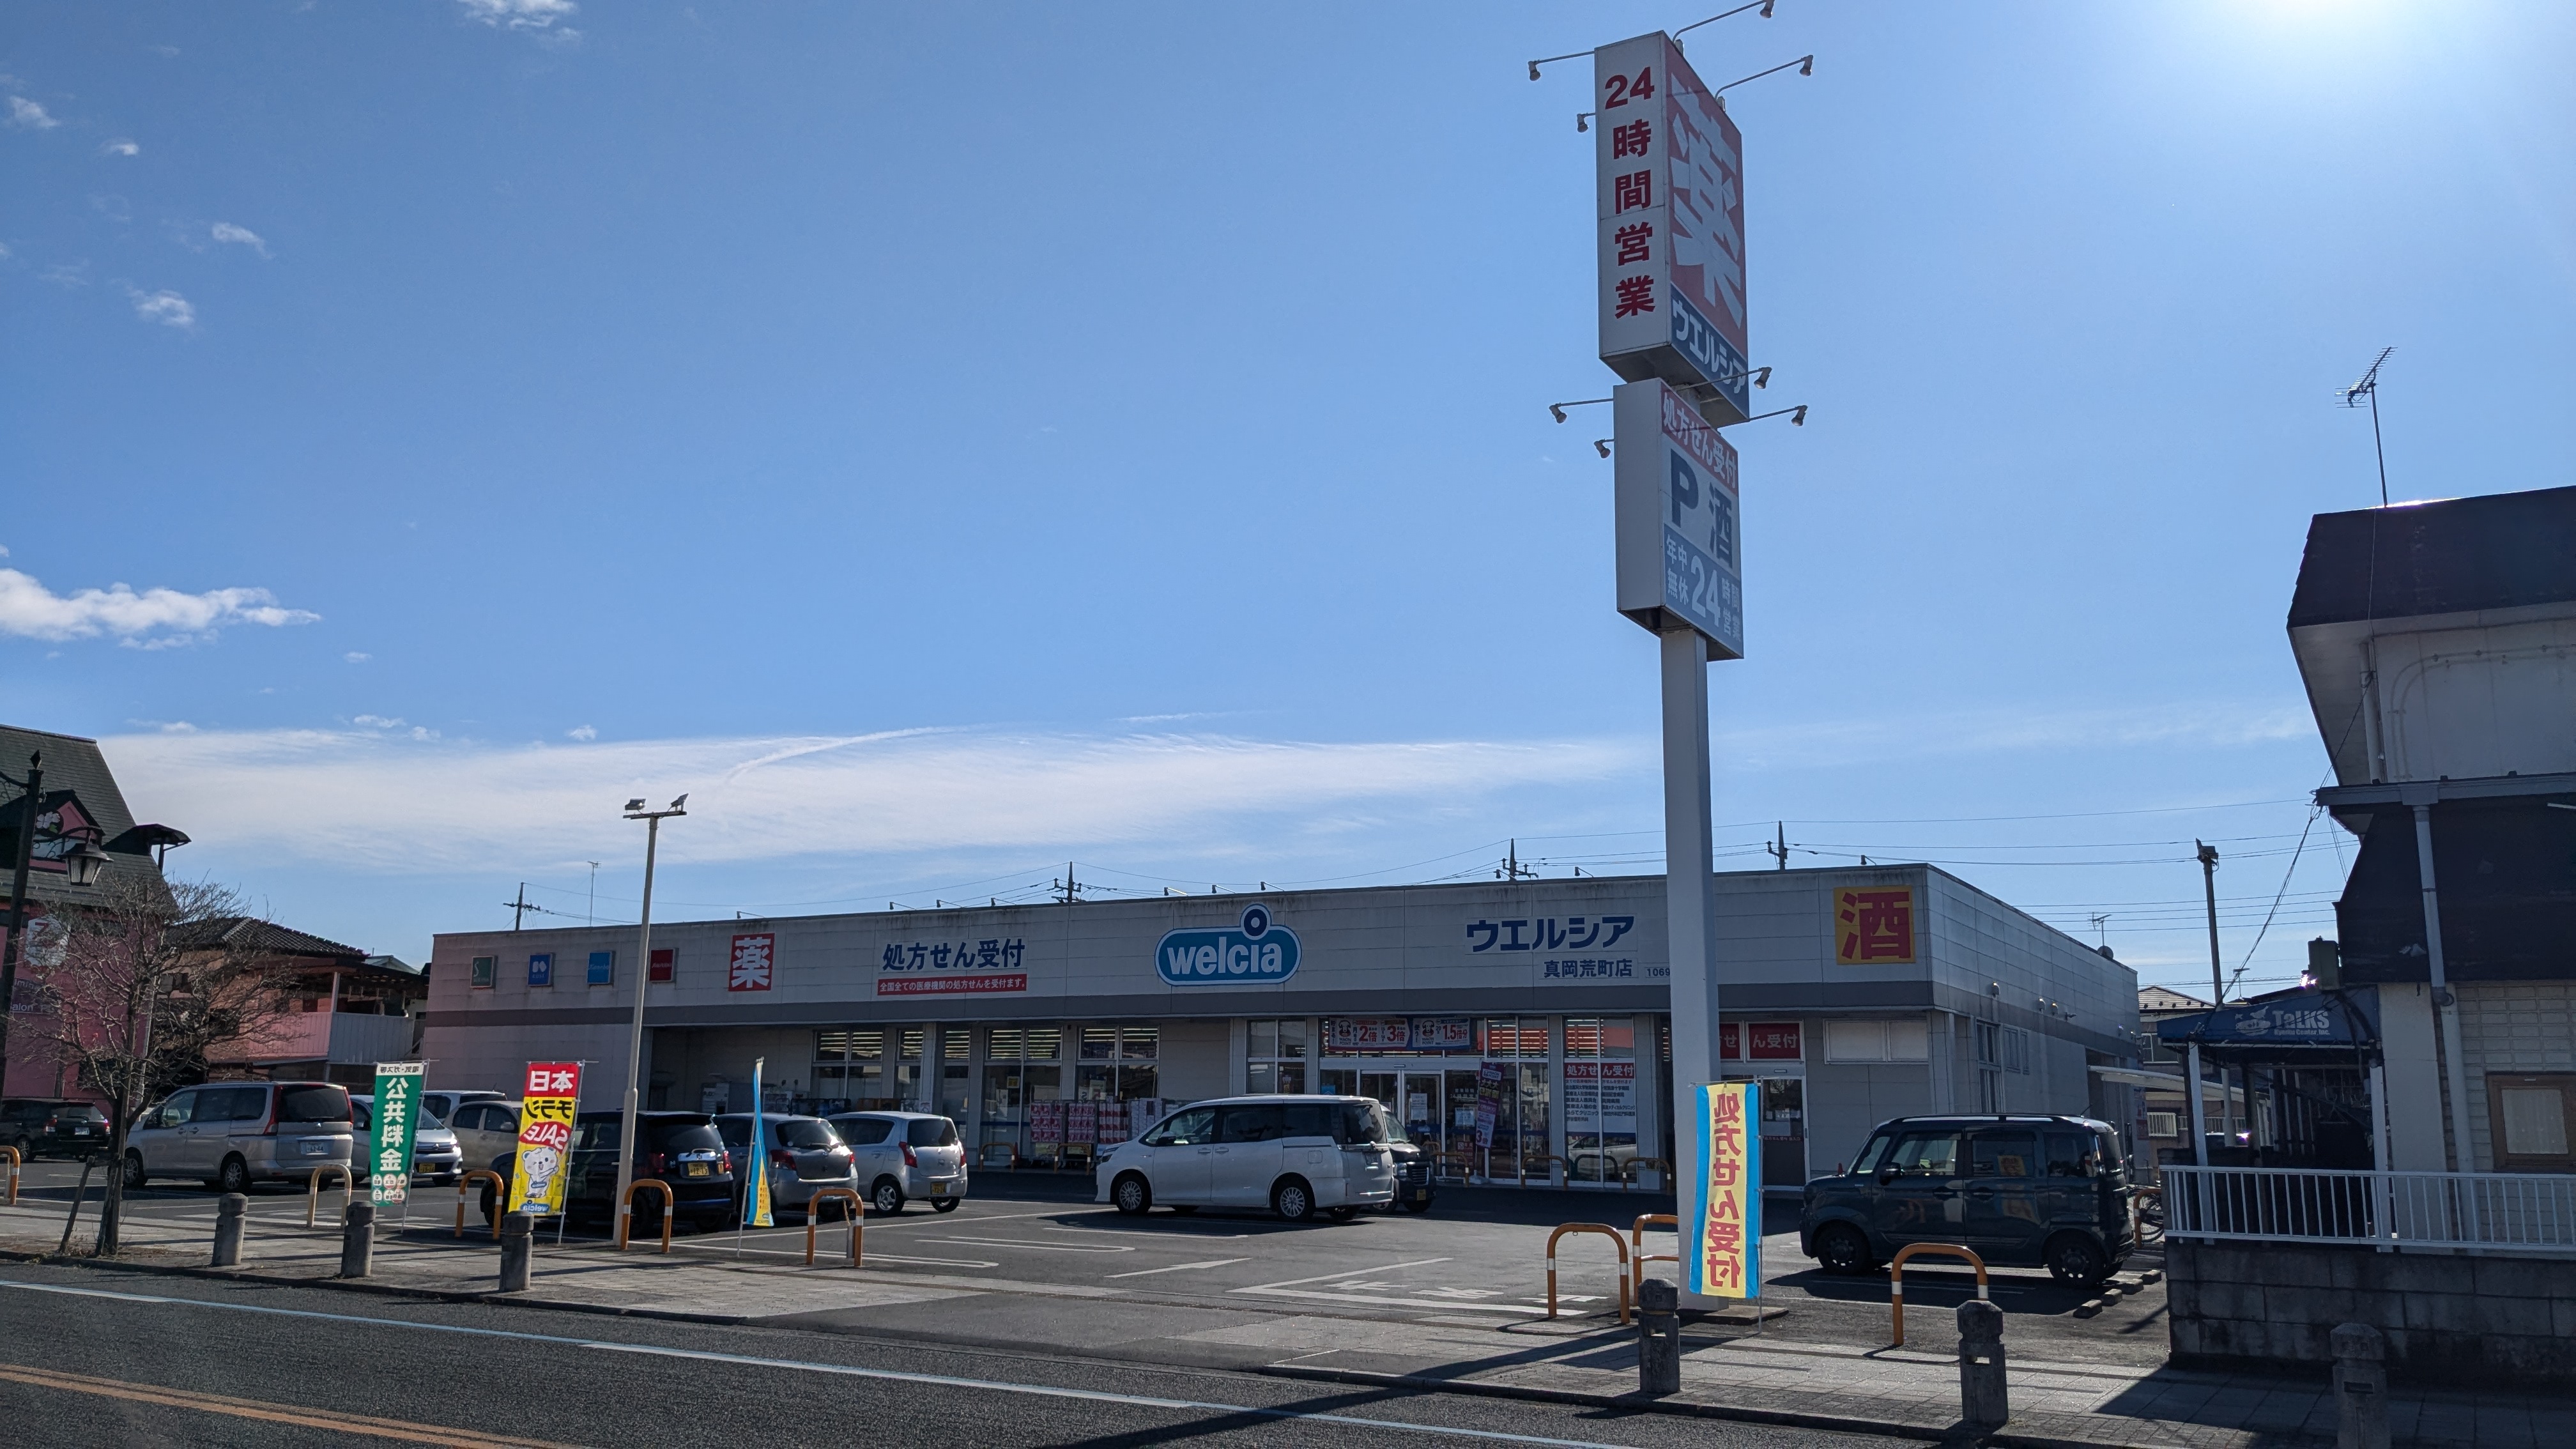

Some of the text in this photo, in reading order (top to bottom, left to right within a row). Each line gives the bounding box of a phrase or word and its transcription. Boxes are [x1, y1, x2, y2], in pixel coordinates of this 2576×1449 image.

[1604, 66, 1656, 319] 24時間営業
[1671, 73, 1743, 330] 薬
[1672, 298, 1747, 395] ウエルシア
[1663, 392, 1737, 489] 処方せん受付
[1670, 448, 1699, 528] P
[1708, 481, 1733, 569] 酒
[882, 938, 1025, 971] 処方せん受付
[1167, 908, 1282, 975] welcia
[1466, 916, 1634, 953] ウエルシア
[1840, 891, 1911, 960] 酒
[731, 936, 772, 989] 薬
[1544, 958, 1632, 977] 真岡荒町店
[12, 1002, 34, 1011] alon
[1567, 1064, 1634, 1076] 処方せん受付
[1720, 1033, 1798, 1048] せん受付
